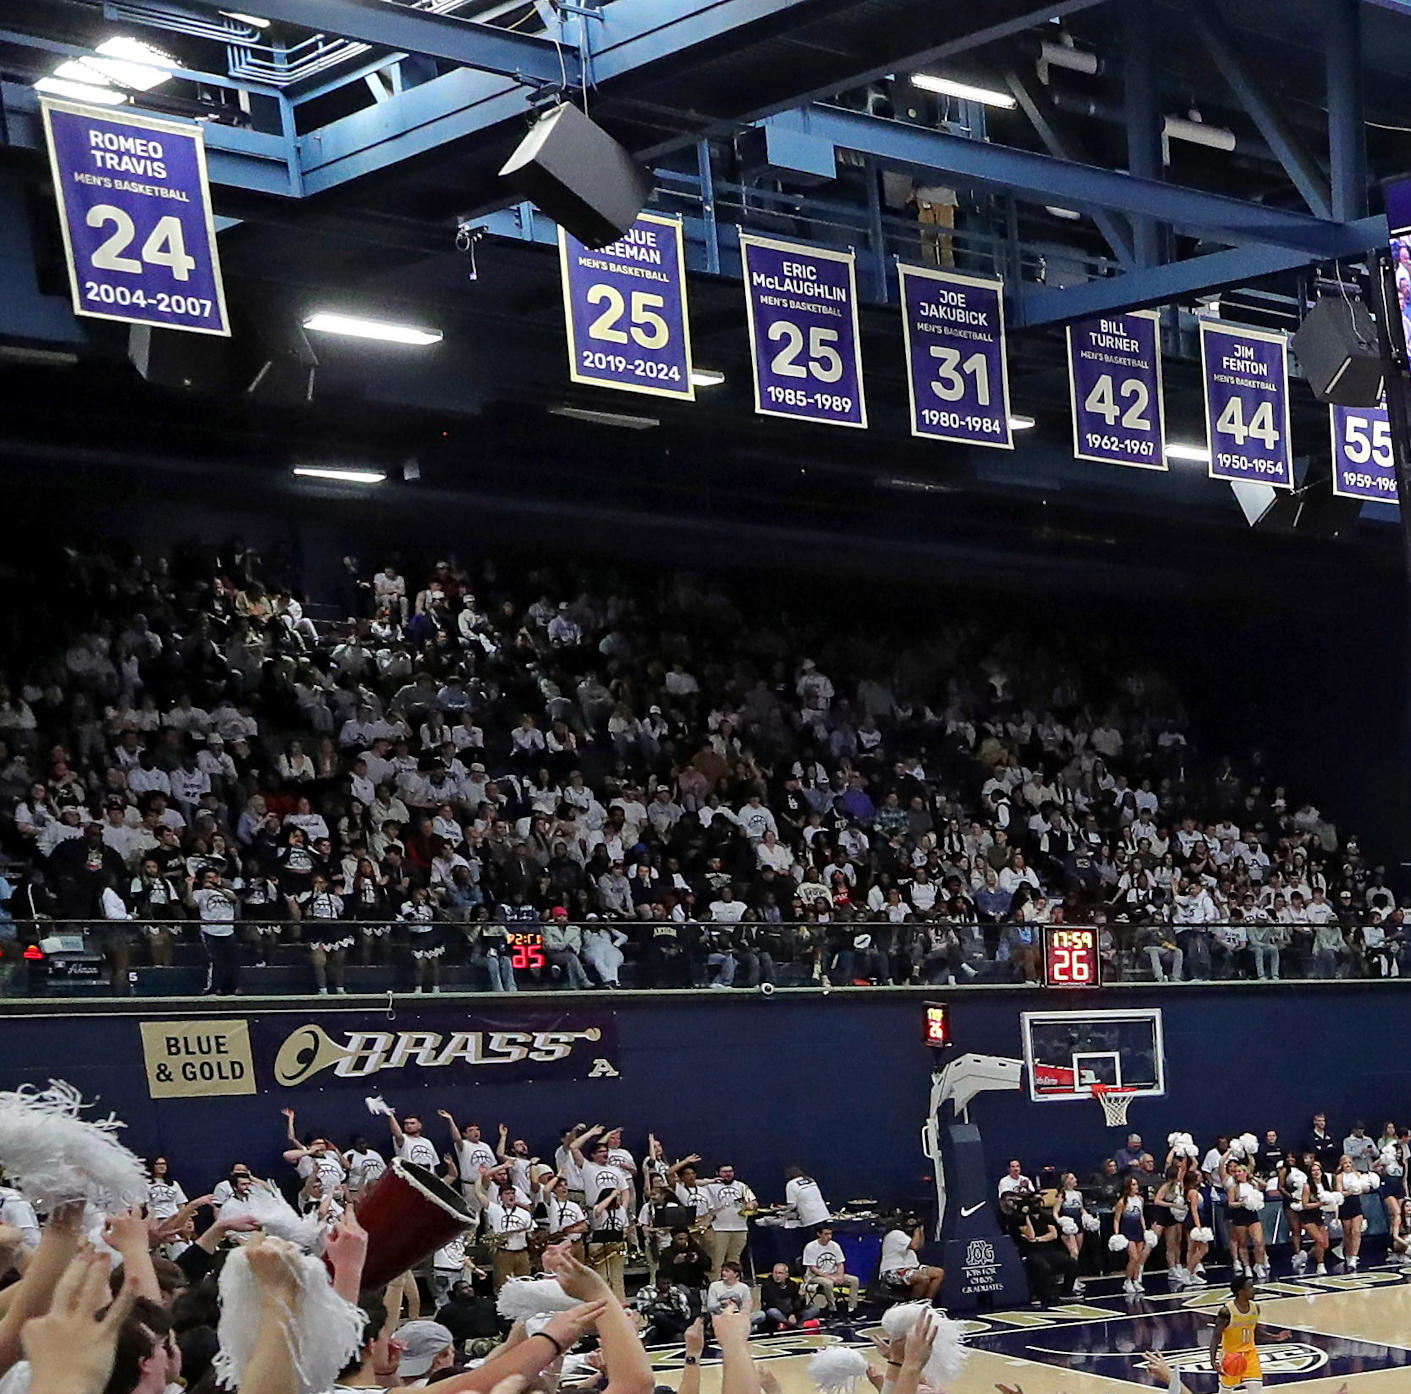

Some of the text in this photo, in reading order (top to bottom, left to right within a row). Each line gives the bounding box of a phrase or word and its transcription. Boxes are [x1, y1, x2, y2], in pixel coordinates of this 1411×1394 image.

[89, 130, 163, 159] ROMEO
[91, 151, 167, 179] TRAVIS
[74, 172, 190, 202] MEN'S BASKETBALL
[86, 204, 195, 281] 24
[579, 257, 670, 283] MEN'S BASKETBALL
[782, 261, 817, 280] ERIC
[753, 272, 846, 302] McLAUGHLIN
[940, 290, 966, 307] JOE
[85, 282, 212, 318] 2004-2007
[760, 295, 842, 318] MEN'S BASKETBALL
[587, 284, 670, 350] 25
[919, 302, 988, 326] JAKUBICK
[917, 322, 993, 342] MEN'S BASKETBALL
[1100, 320, 1127, 336] BILL
[768, 320, 843, 383] 25
[1089, 332, 1139, 353] TURNER
[1234, 345, 1254, 360] JIM
[582, 351, 681, 381] 2019-2024
[1081, 351, 1149, 369] MEN'S BASKETBALL
[1223, 358, 1268, 376] FENTON
[930, 346, 990, 406] 31
[1214, 374, 1277, 391] MEN'S BASKETBALL
[767, 386, 852, 412] 1985-1989
[1085, 375, 1150, 430] 42
[922, 409, 1000, 434] 1980-1984
[1217, 396, 1279, 450] 44
[1086, 433, 1154, 456] 1962-1967
[1344, 415, 1394, 467] 55
[1217, 453, 1284, 475] 1950-1954
[1053, 931, 1092, 949] 17:59
[1054, 951, 1089, 981] 26
[165, 1034, 229, 1057] BLUE
[333, 1031, 576, 1078] BRASS
[156, 1059, 245, 1082] & GOLD
